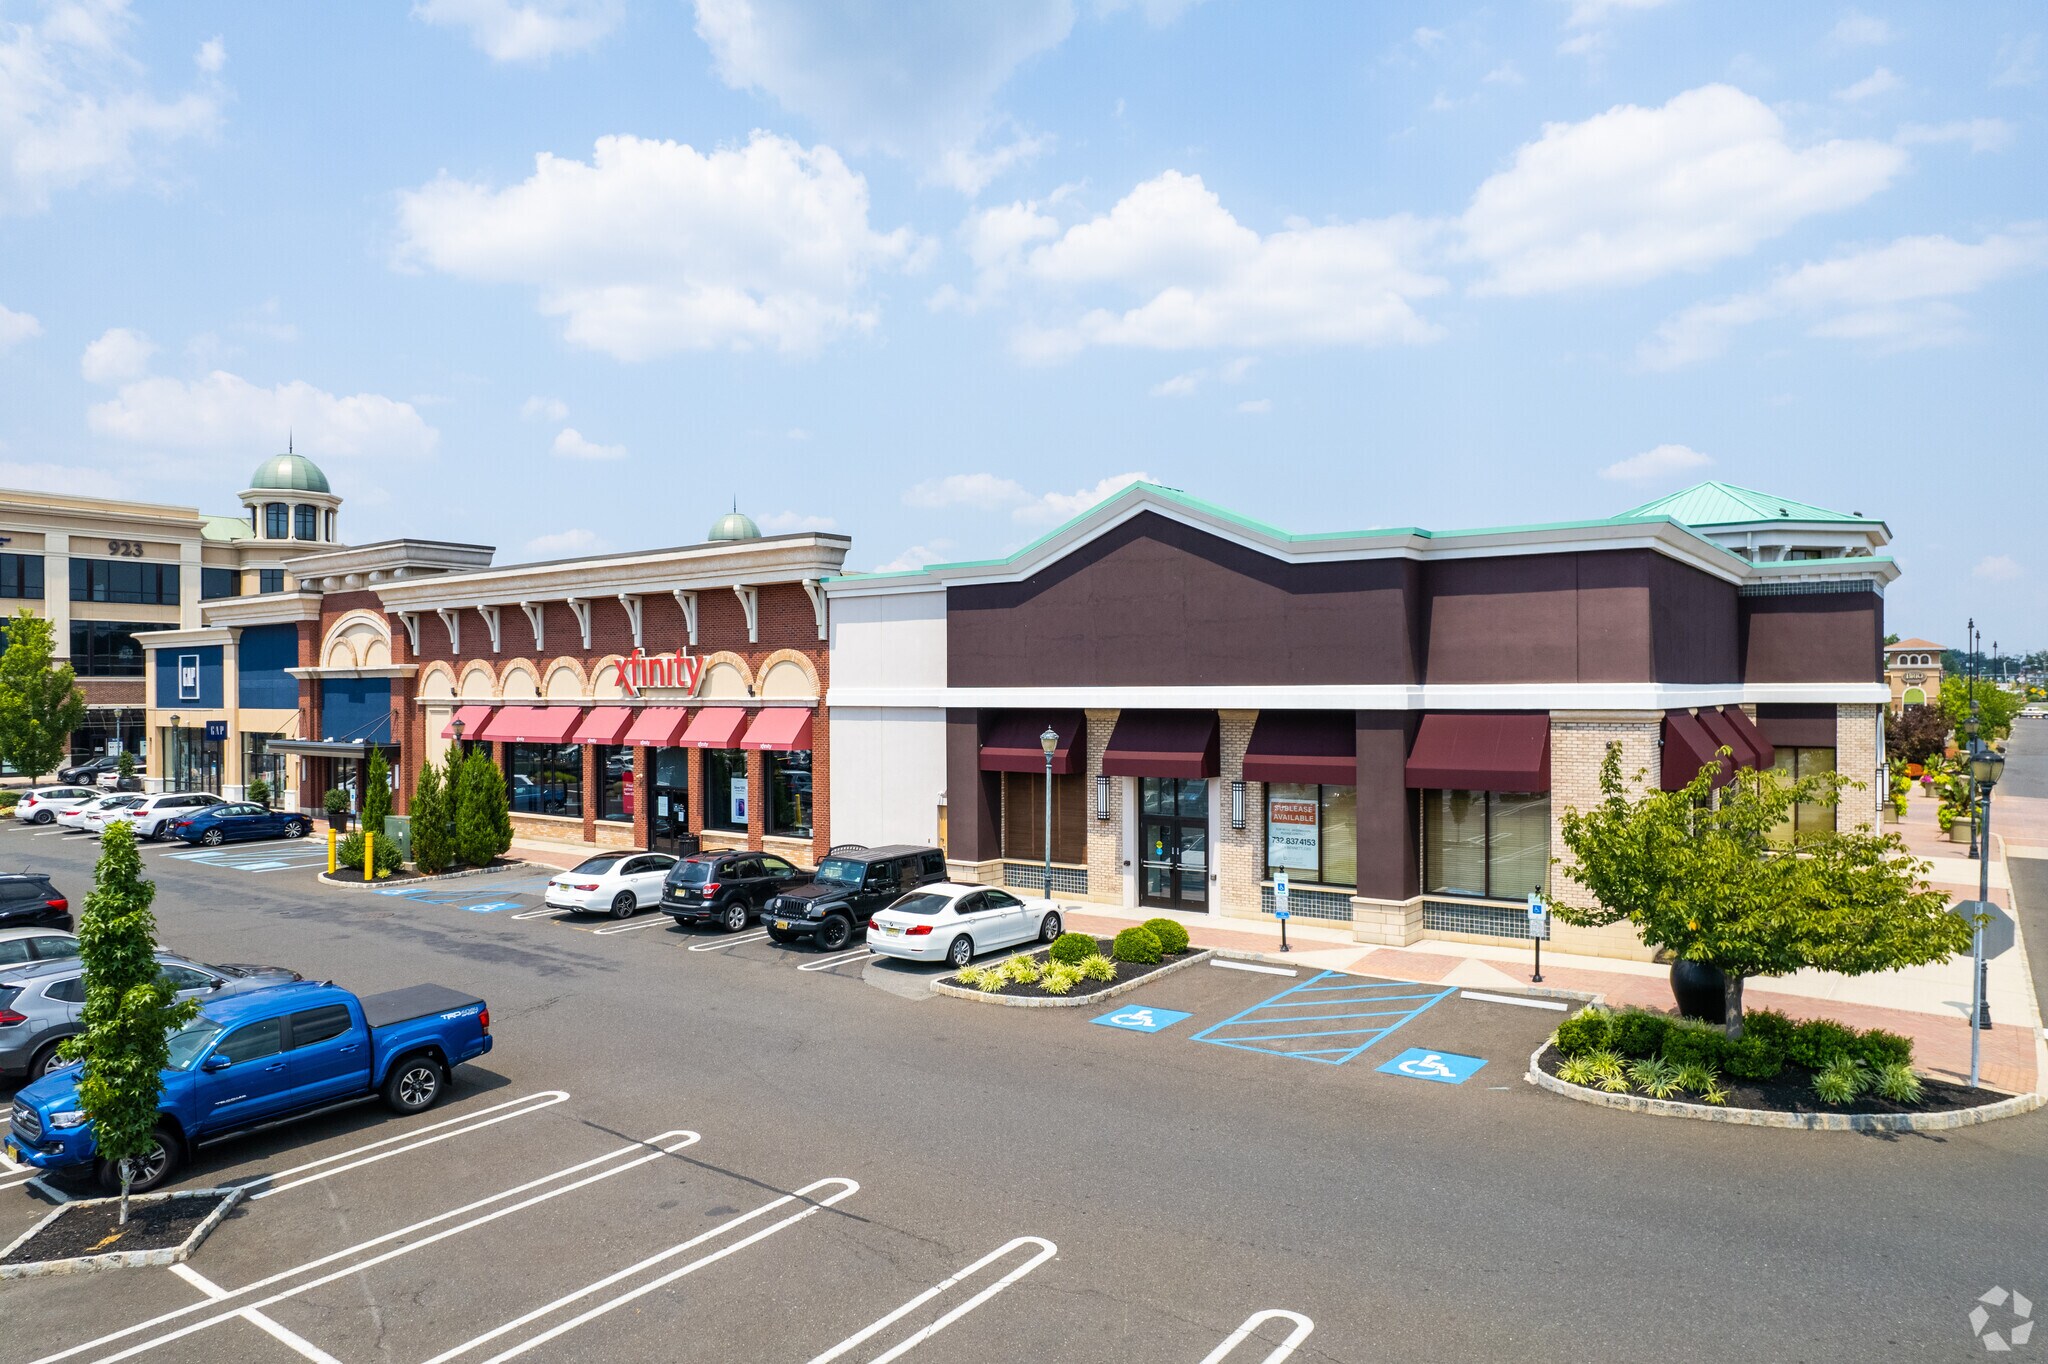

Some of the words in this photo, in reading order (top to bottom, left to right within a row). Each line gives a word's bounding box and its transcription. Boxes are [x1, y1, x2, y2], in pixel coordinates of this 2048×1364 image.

[108, 541, 144, 557] 923
[614, 647, 705, 696] xfinity
[210, 725, 225, 736] GAP
[1273, 805, 1313, 813] SUBLEASE
[1273, 813, 1314, 822] AVAILABLE
